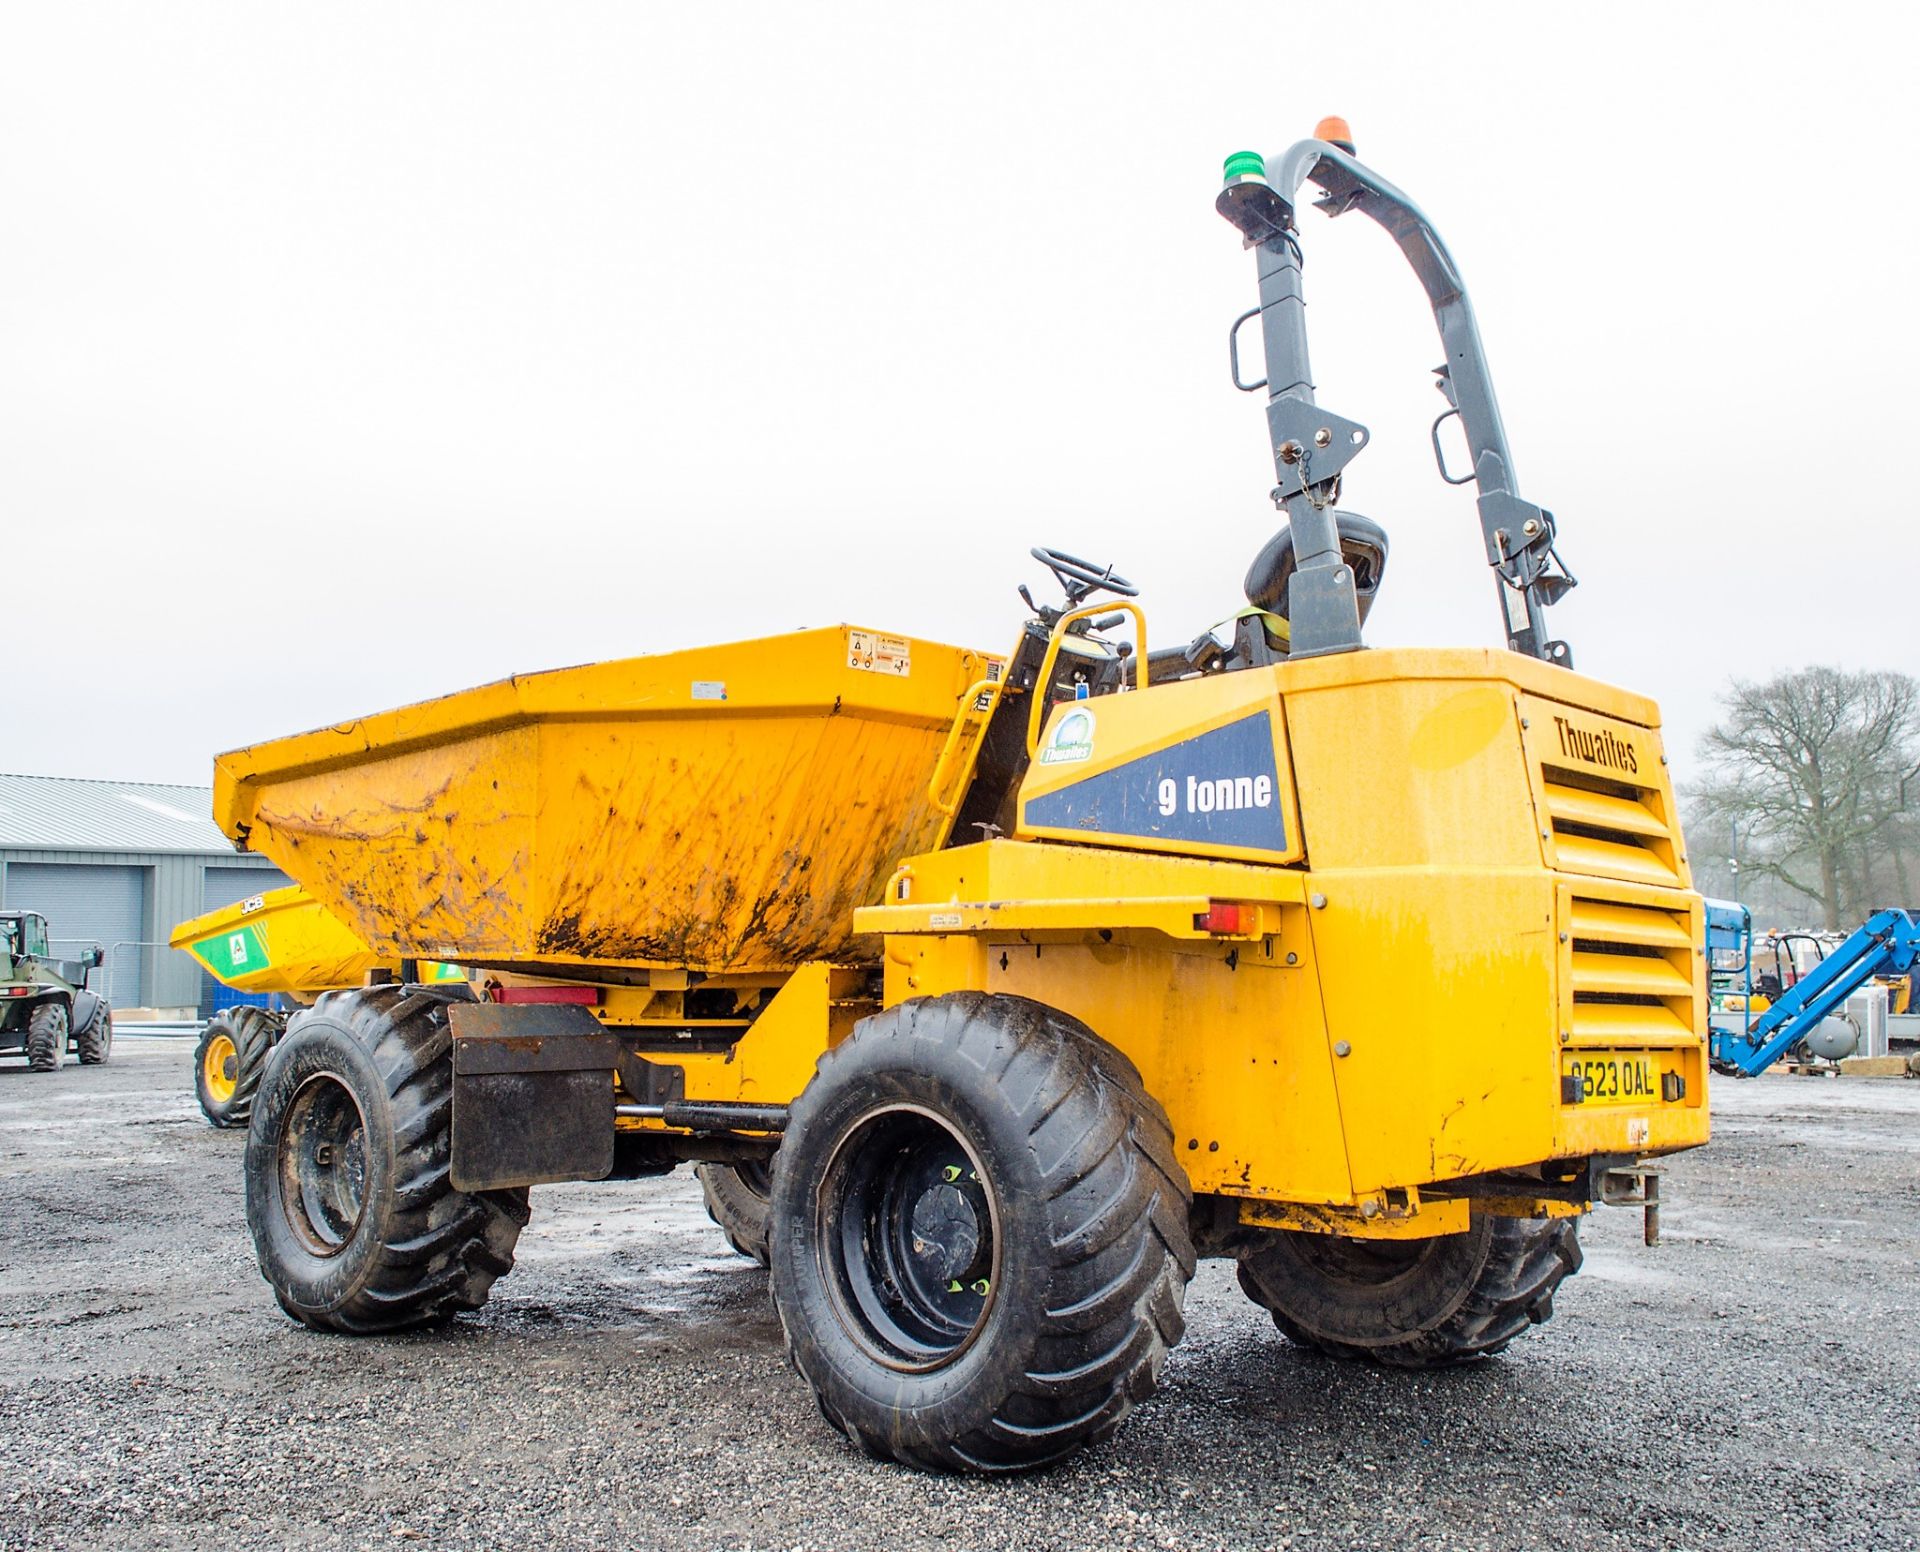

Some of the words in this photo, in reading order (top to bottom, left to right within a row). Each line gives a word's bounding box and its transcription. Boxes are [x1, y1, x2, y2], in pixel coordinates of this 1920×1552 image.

[1043, 746, 1090, 763] Thwaites
[1553, 716, 1637, 774] Thwaites
[1158, 778, 1177, 816] 9
[1186, 774, 1272, 814] tonne
[241, 896, 265, 915] JCB
